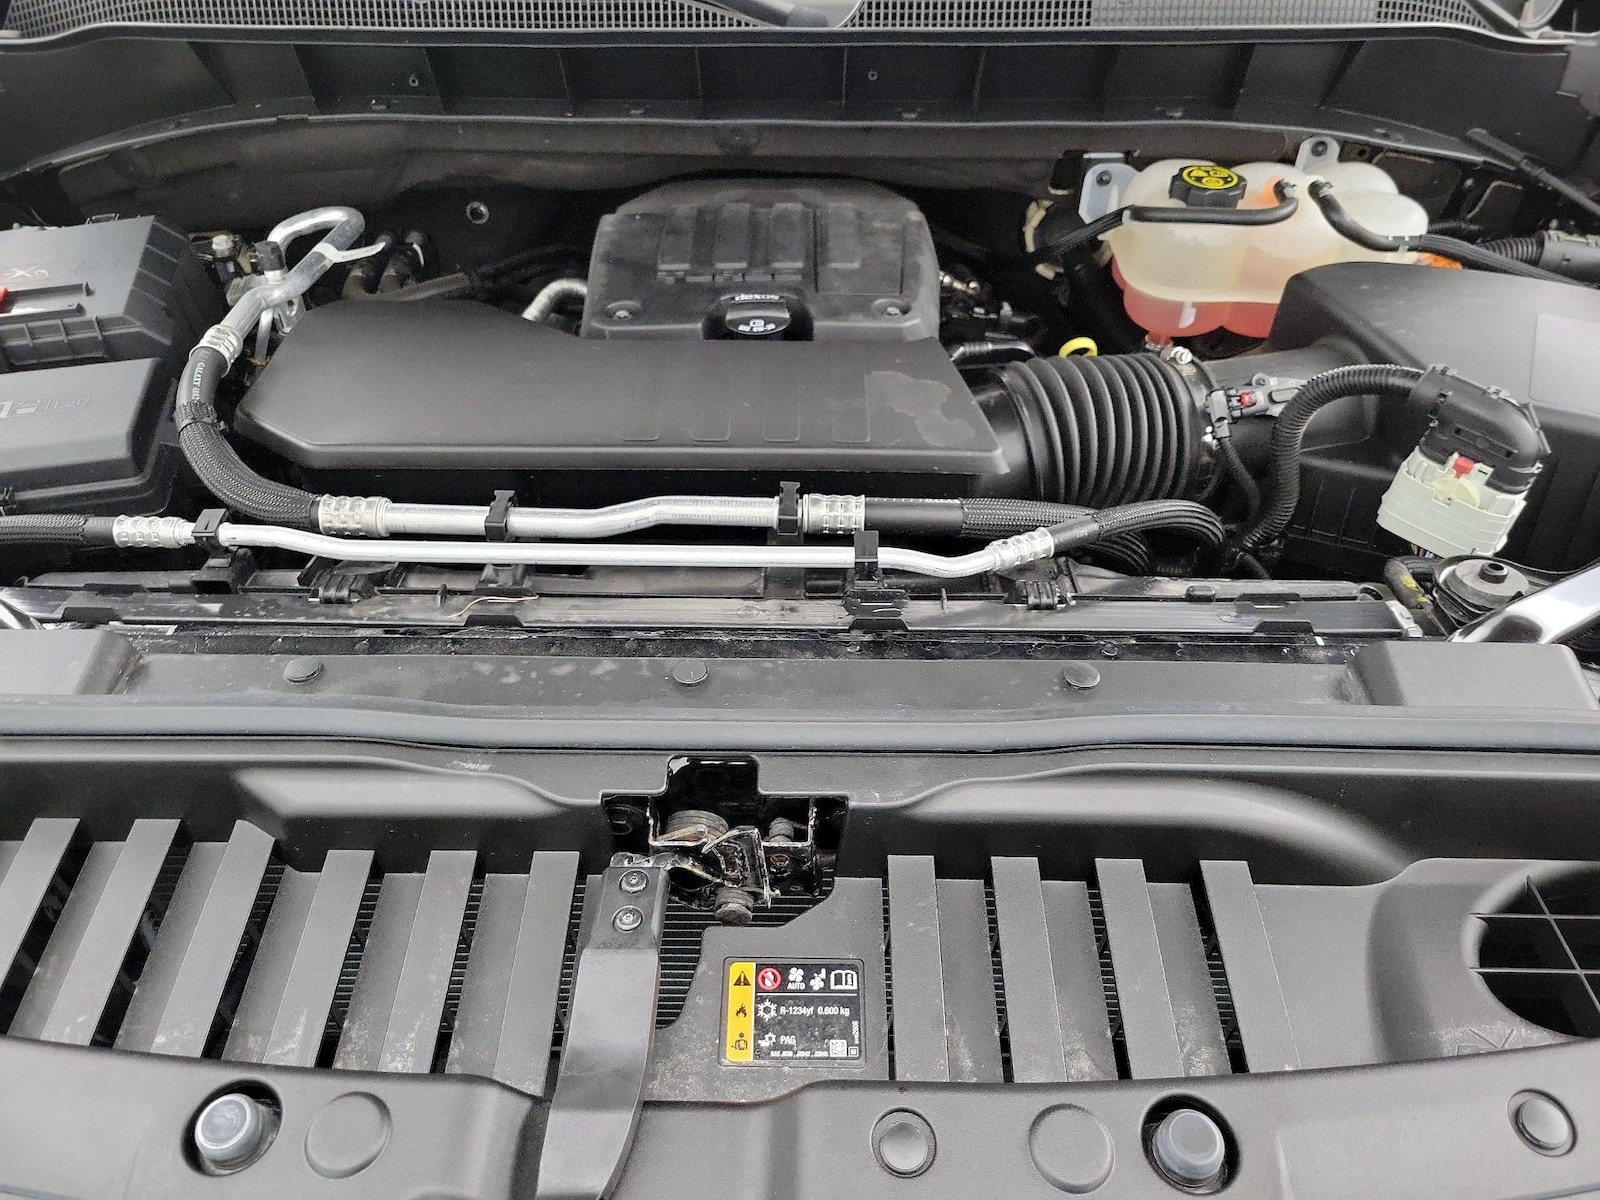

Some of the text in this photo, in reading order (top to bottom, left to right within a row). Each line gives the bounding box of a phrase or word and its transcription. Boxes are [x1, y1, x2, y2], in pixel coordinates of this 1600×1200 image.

[787, 982, 806, 990] AUTO
[780, 1006, 850, 1016] R-1234yf 0.600 kg
[780, 1035, 797, 1045] PAG
